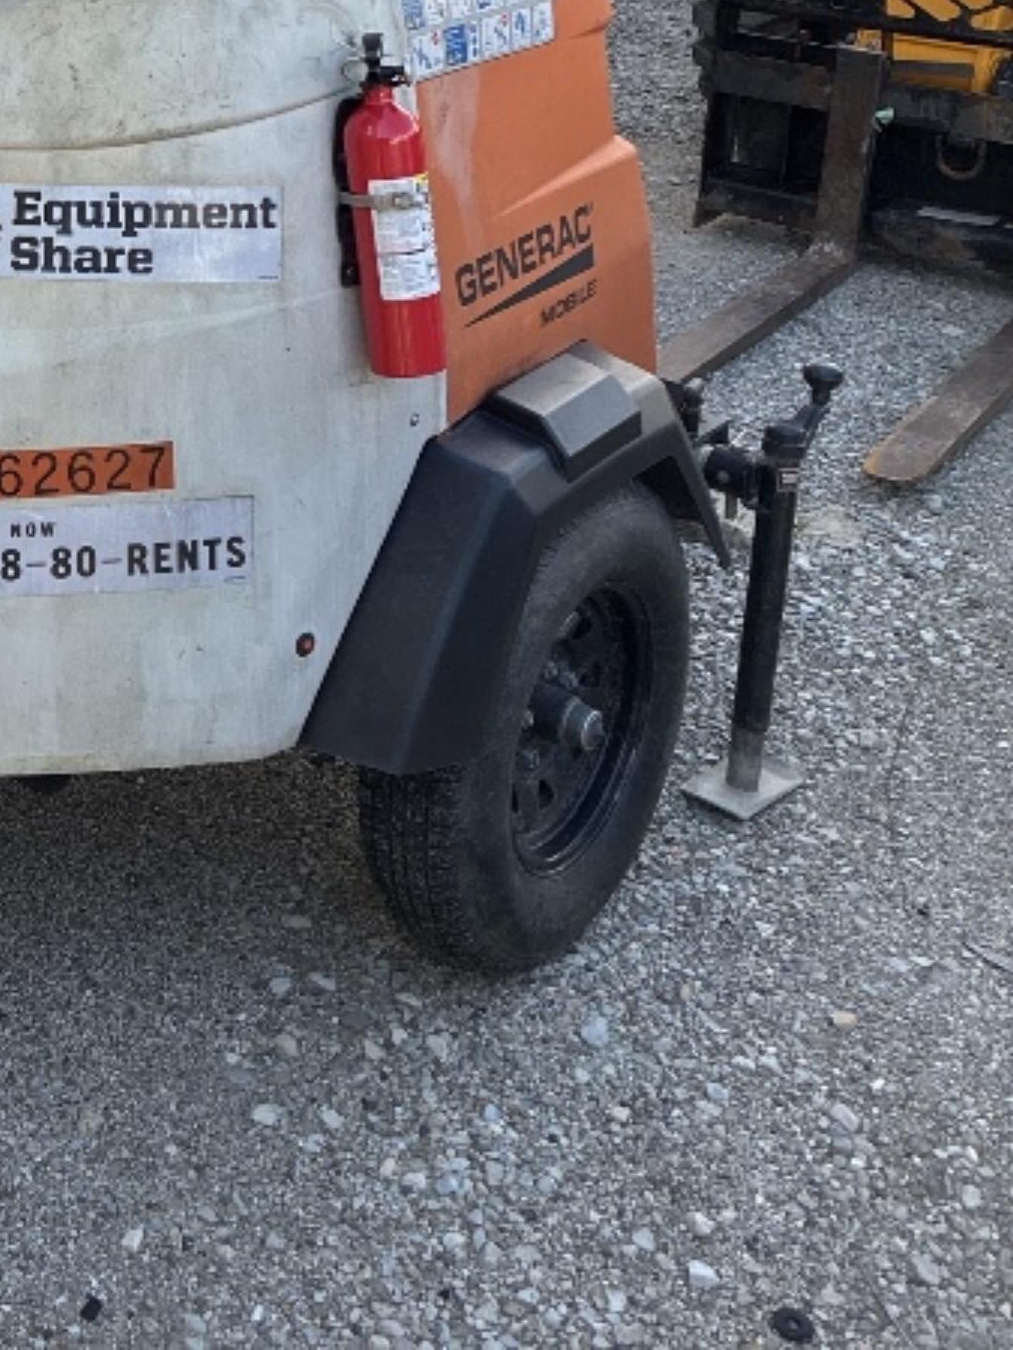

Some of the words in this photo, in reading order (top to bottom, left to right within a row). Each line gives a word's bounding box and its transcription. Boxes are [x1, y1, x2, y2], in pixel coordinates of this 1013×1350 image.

[12, 191, 279, 238] Equipment
[10, 236, 154, 275] Share
[455, 204, 591, 307] GENERAC
[540, 279, 597, 318] MOBILE
[10, 521, 57, 539] NOW
